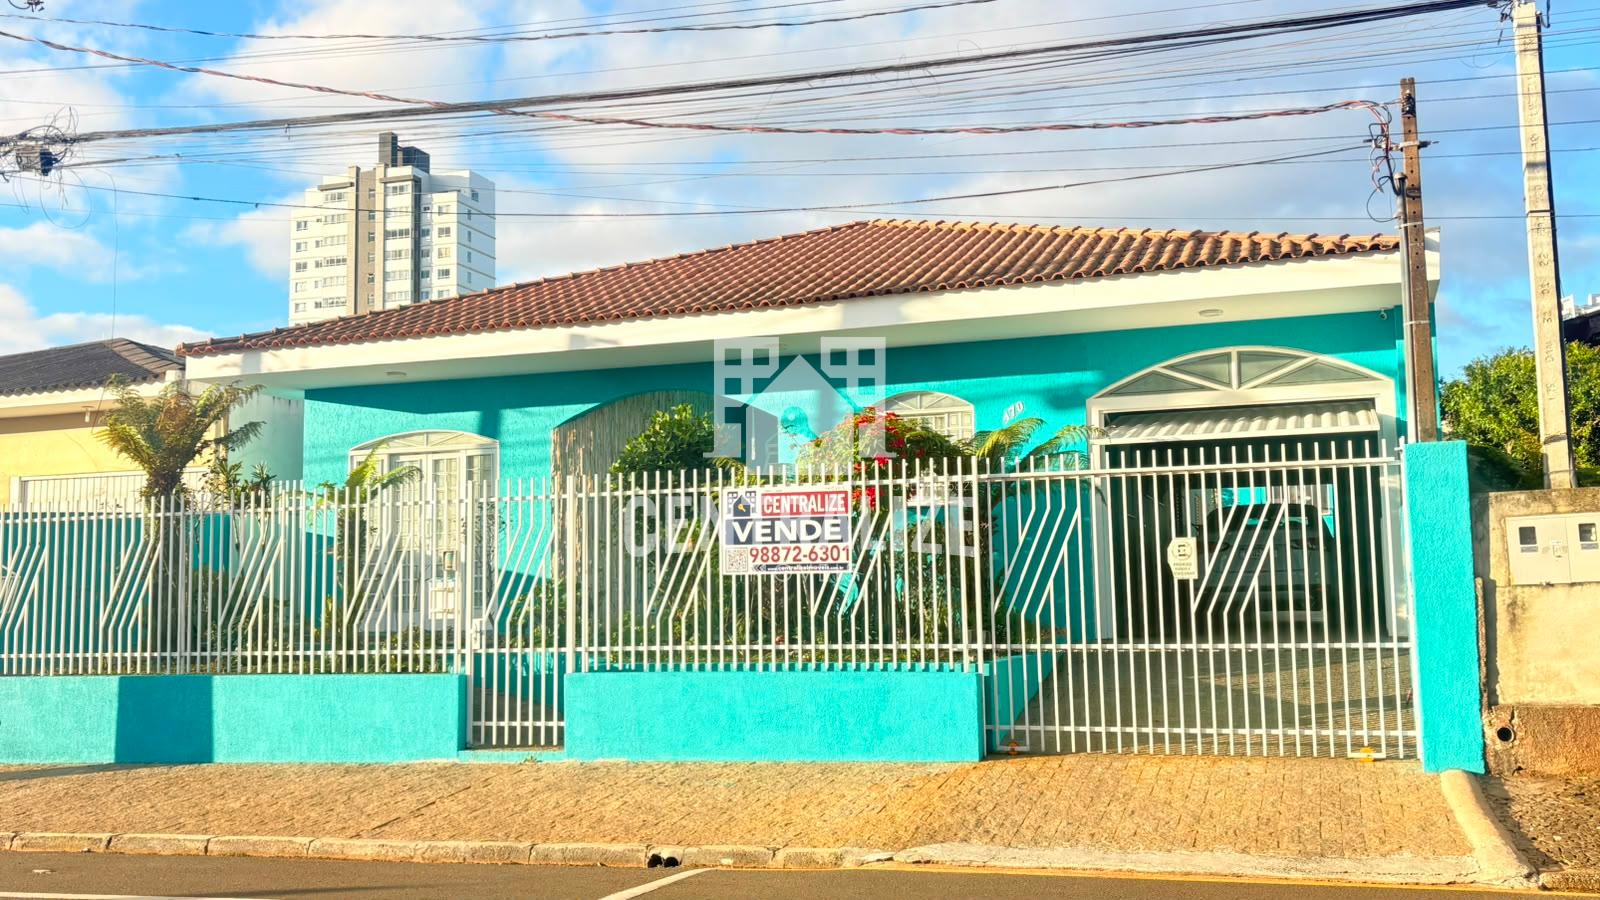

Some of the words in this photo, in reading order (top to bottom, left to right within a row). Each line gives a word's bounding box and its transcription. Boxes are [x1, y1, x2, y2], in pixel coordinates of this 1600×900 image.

[763, 493, 846, 514] CENTRALIZE
[732, 518, 842, 543] VENDE
[750, 545, 849, 563] 98872-6301
